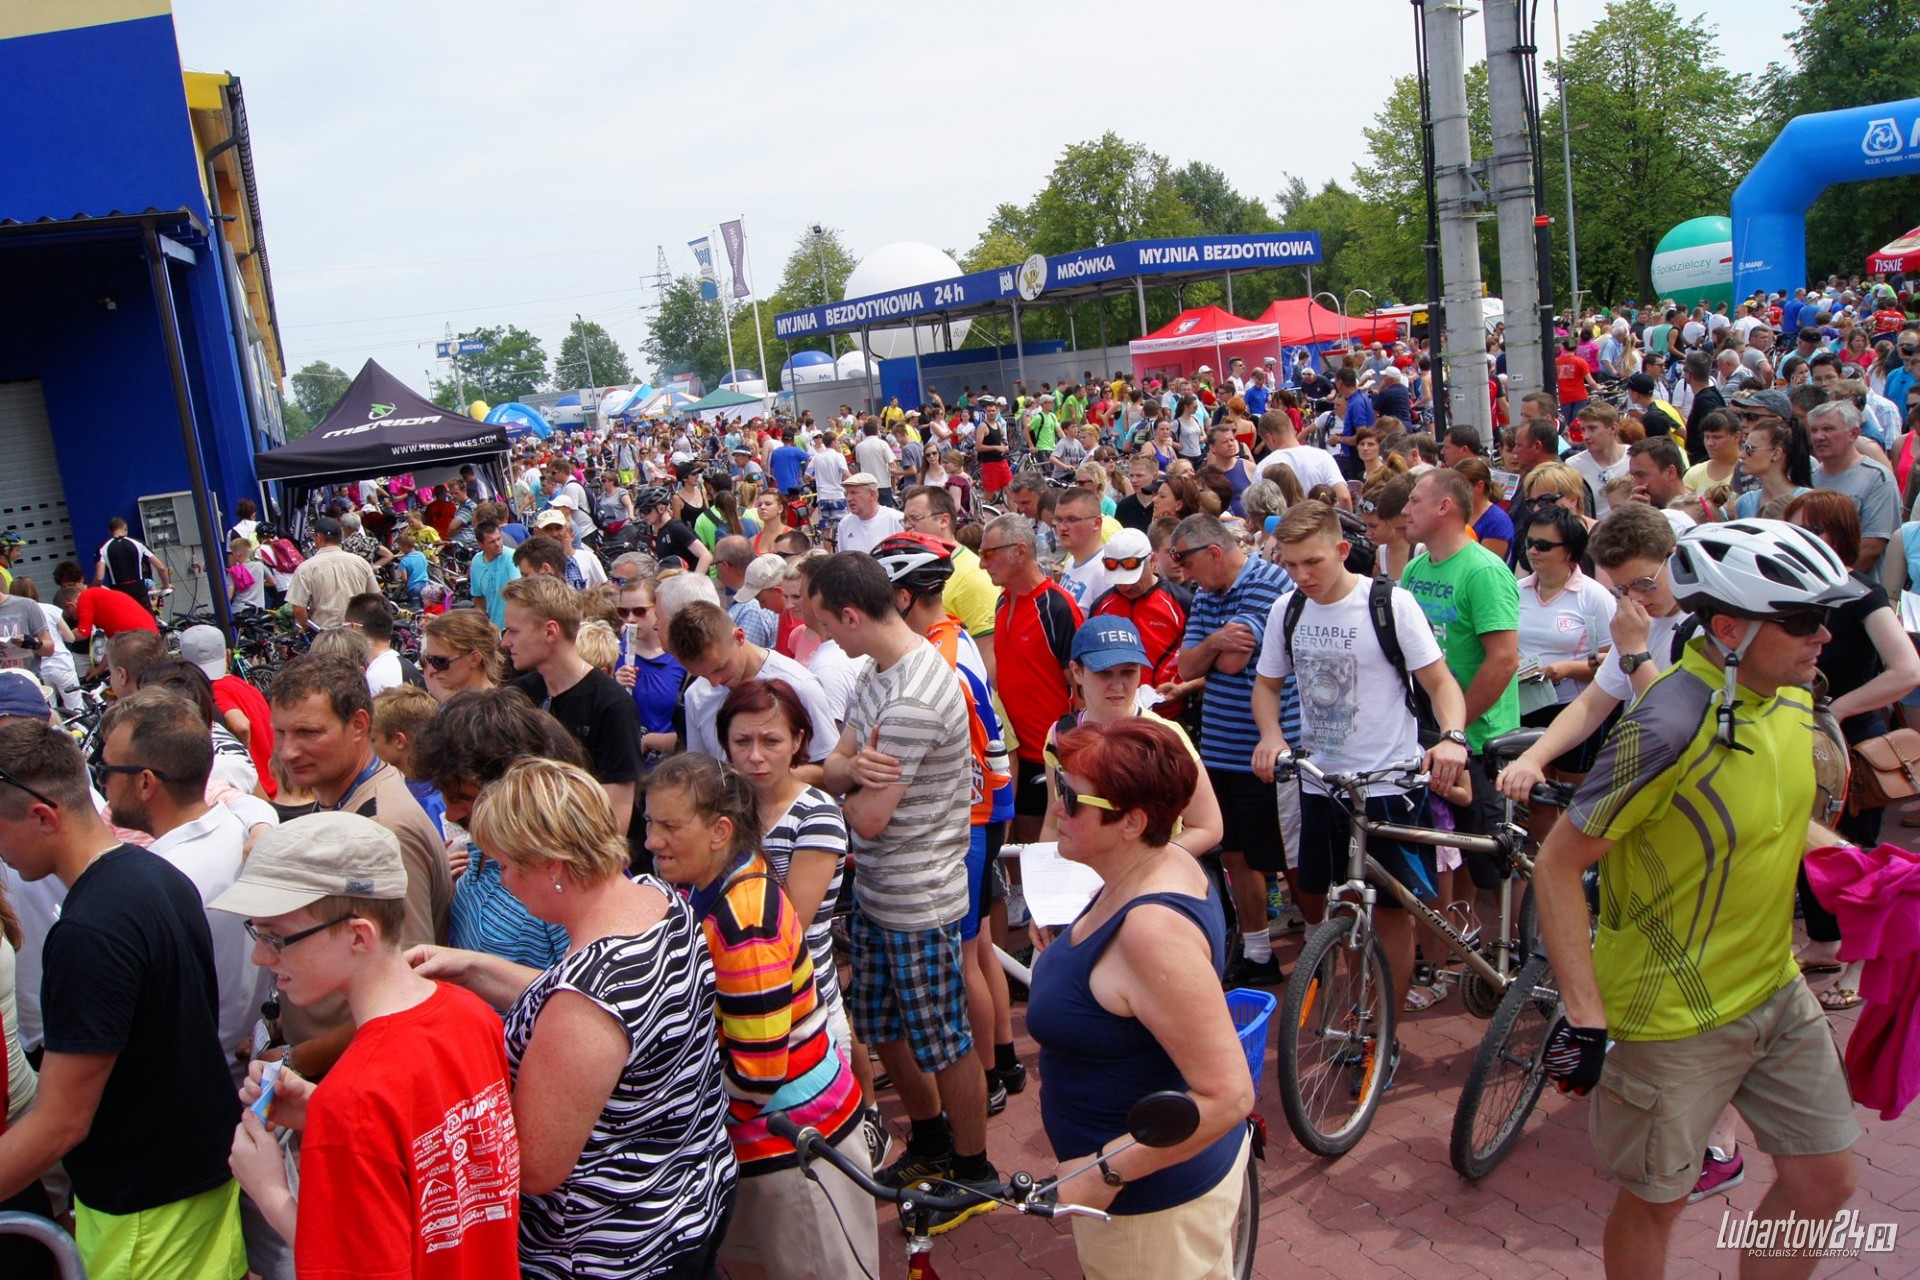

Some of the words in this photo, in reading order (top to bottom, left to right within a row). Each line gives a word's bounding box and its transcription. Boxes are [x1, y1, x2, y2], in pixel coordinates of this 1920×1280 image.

[1138, 246, 1199, 265] MYJNIA
[1203, 240, 1315, 261] BEZDOTYKOWA
[1057, 254, 1116, 280] MRÓWKA
[1656, 258, 1712, 276] Spółdzielczy
[1874, 257, 1904, 273] TYSKIE
[776, 312, 818, 336] MYJNIA
[825, 291, 924, 327] BEZDOTYKOWA
[321, 415, 443, 439] MERIDA
[391, 434, 498, 456] WWW.MERIDA-BIKES.COM
[1096, 630, 1138, 646] TEEN
[1294, 635, 1353, 650] SERVICE
[1414, 899, 1473, 954] SCHWINN
[427, 1185, 448, 1197] Roto
